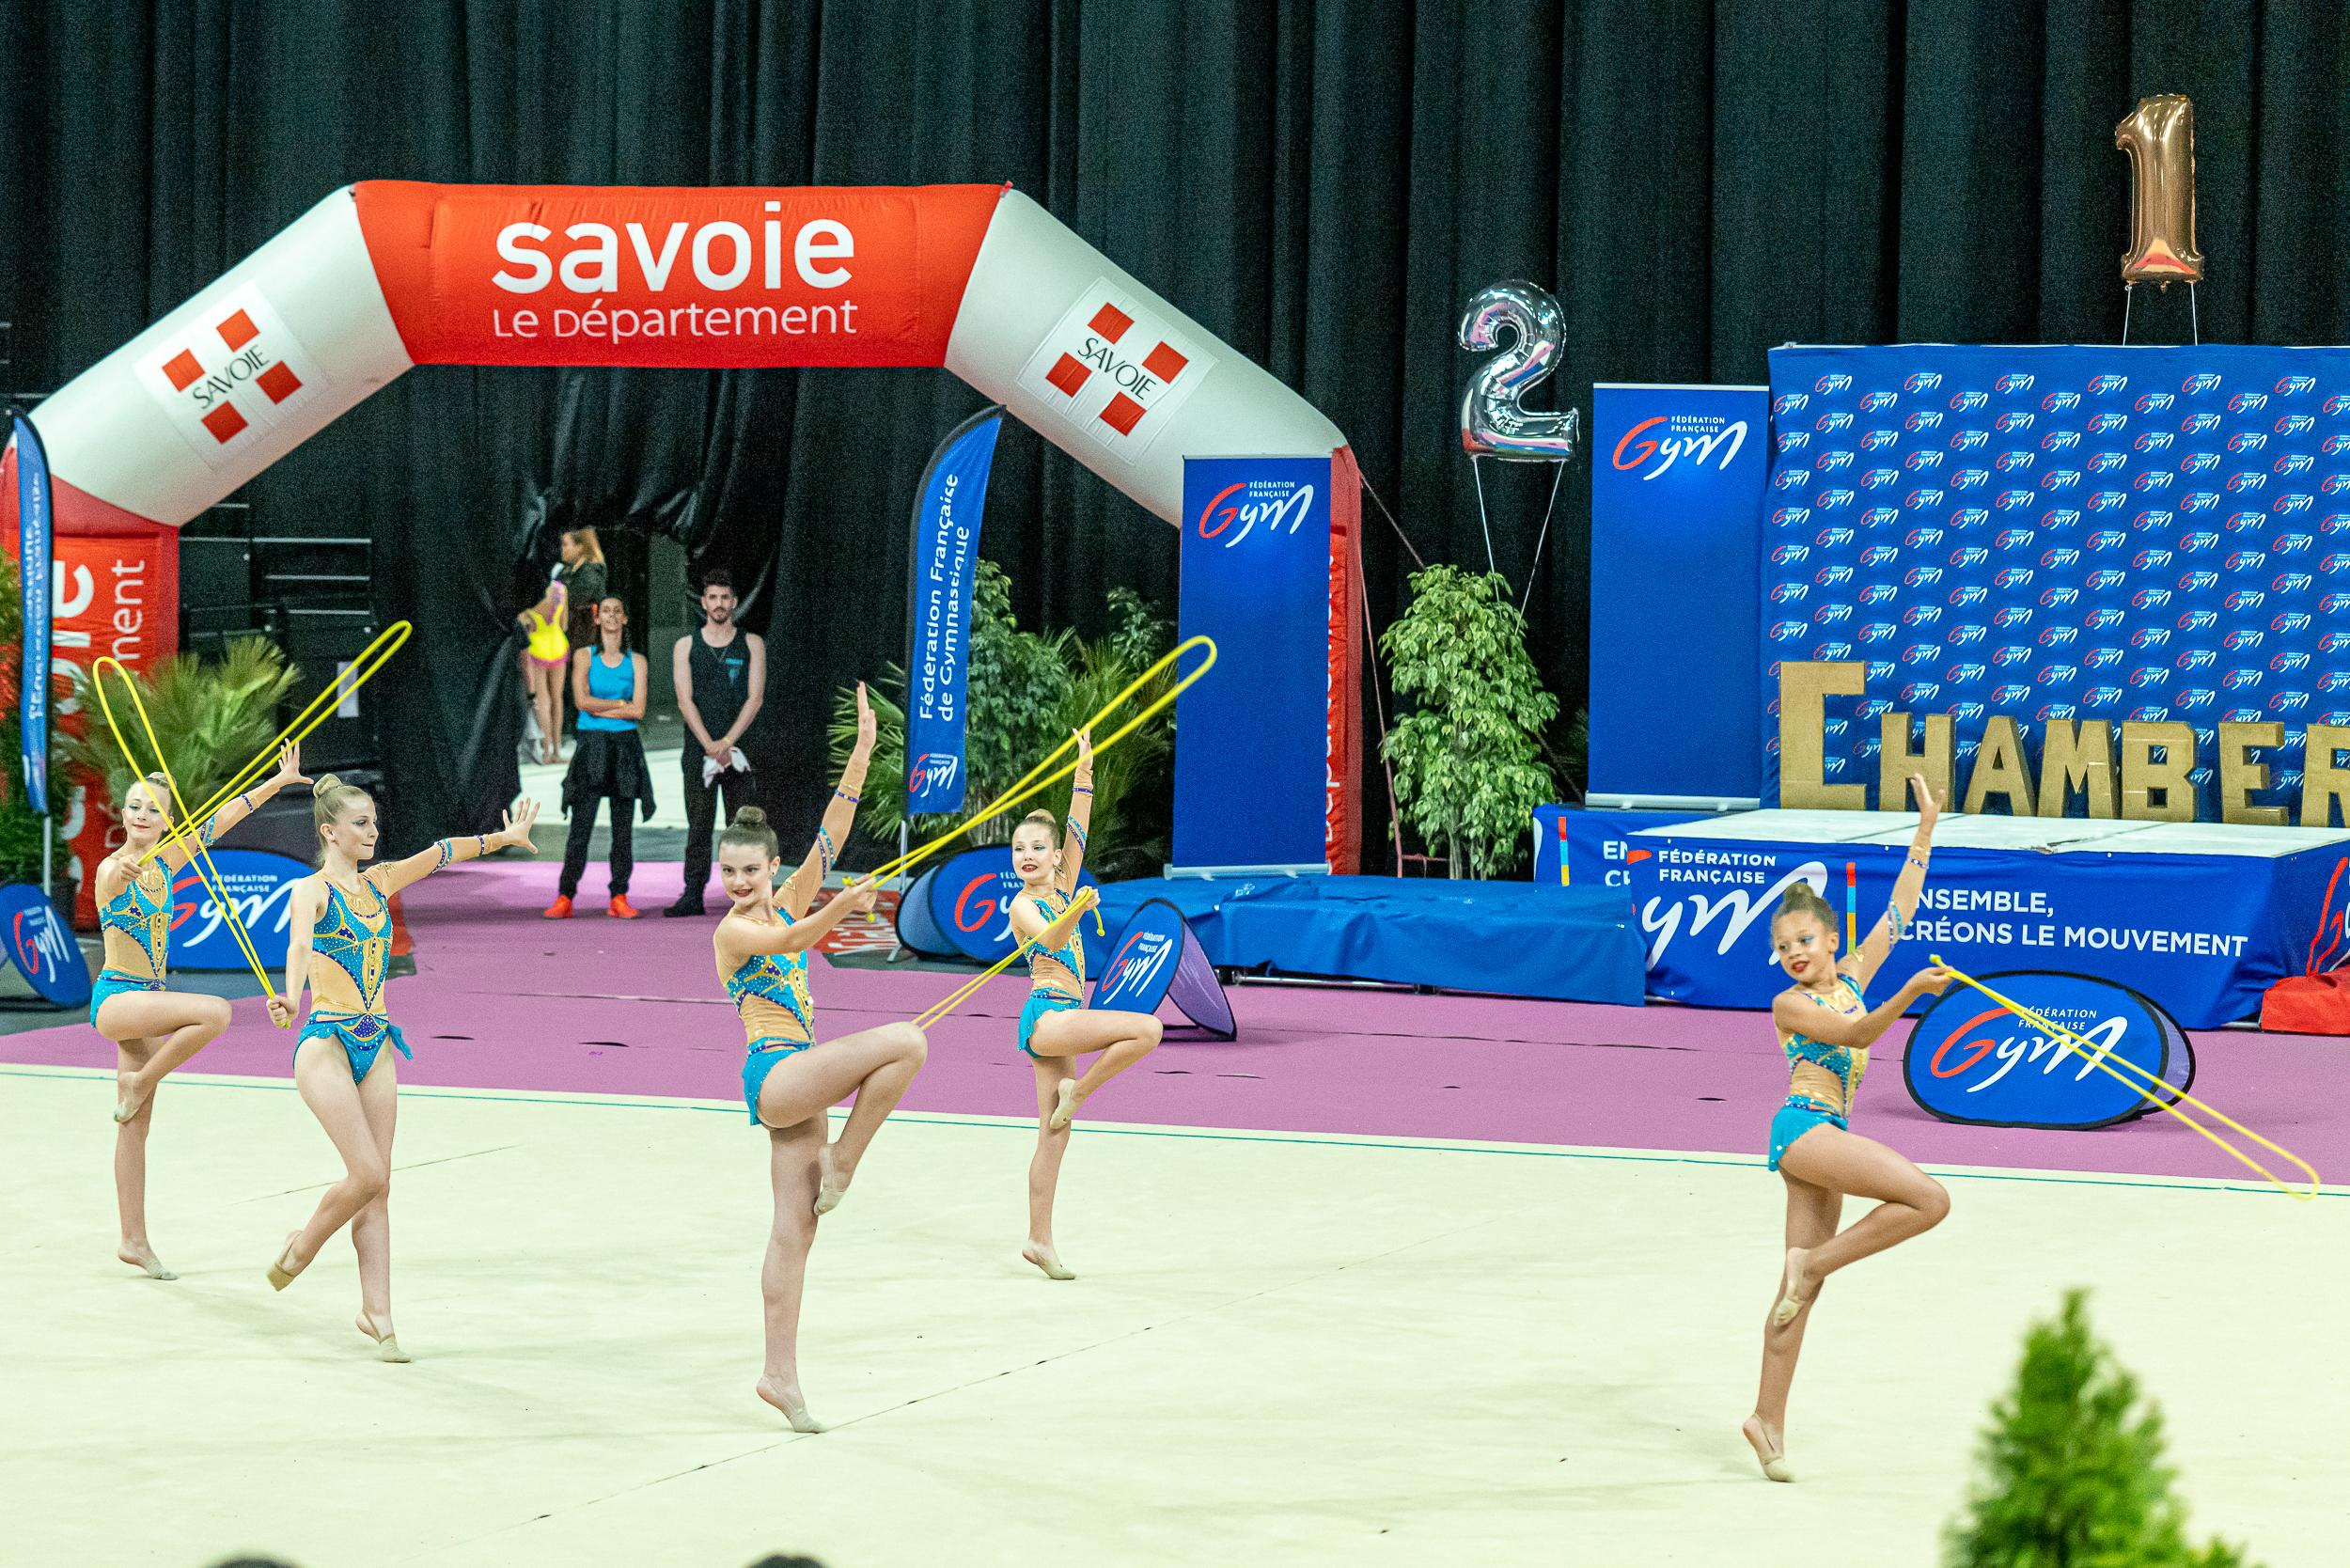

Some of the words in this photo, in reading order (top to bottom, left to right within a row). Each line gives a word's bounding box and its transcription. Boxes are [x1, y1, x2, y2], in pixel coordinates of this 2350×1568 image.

[2115, 95, 2204, 285] 1
[492, 200, 854, 294] savoie
[494, 308, 539, 338] Le
[554, 299, 858, 344] Département
[193, 344, 270, 410] SAVOIE
[1077, 337, 1157, 400] SAVOIE
[1458, 279, 1580, 461] 2
[1670, 415, 1725, 425] FÉDÉRATION
[1670, 425, 1719, 433] FRANÇAISE
[1248, 491, 1290, 499] FRANÇAISE
[1249, 480, 1295, 489] FÉDÉRATION
[930, 474, 959, 582] Française
[940, 525, 970, 685] Gymnastique
[919, 590, 942, 719] Fédération
[938, 692, 953, 722] de
[1658, 849, 1777, 867] FÉDÉRATION
[1658, 869, 1765, 885] FRANÇAISE
[1916, 888, 2054, 917] NSEMBLE,
[2021, 924, 2056, 947] LE
[2064, 926, 2248, 958] MOUVEMENT
